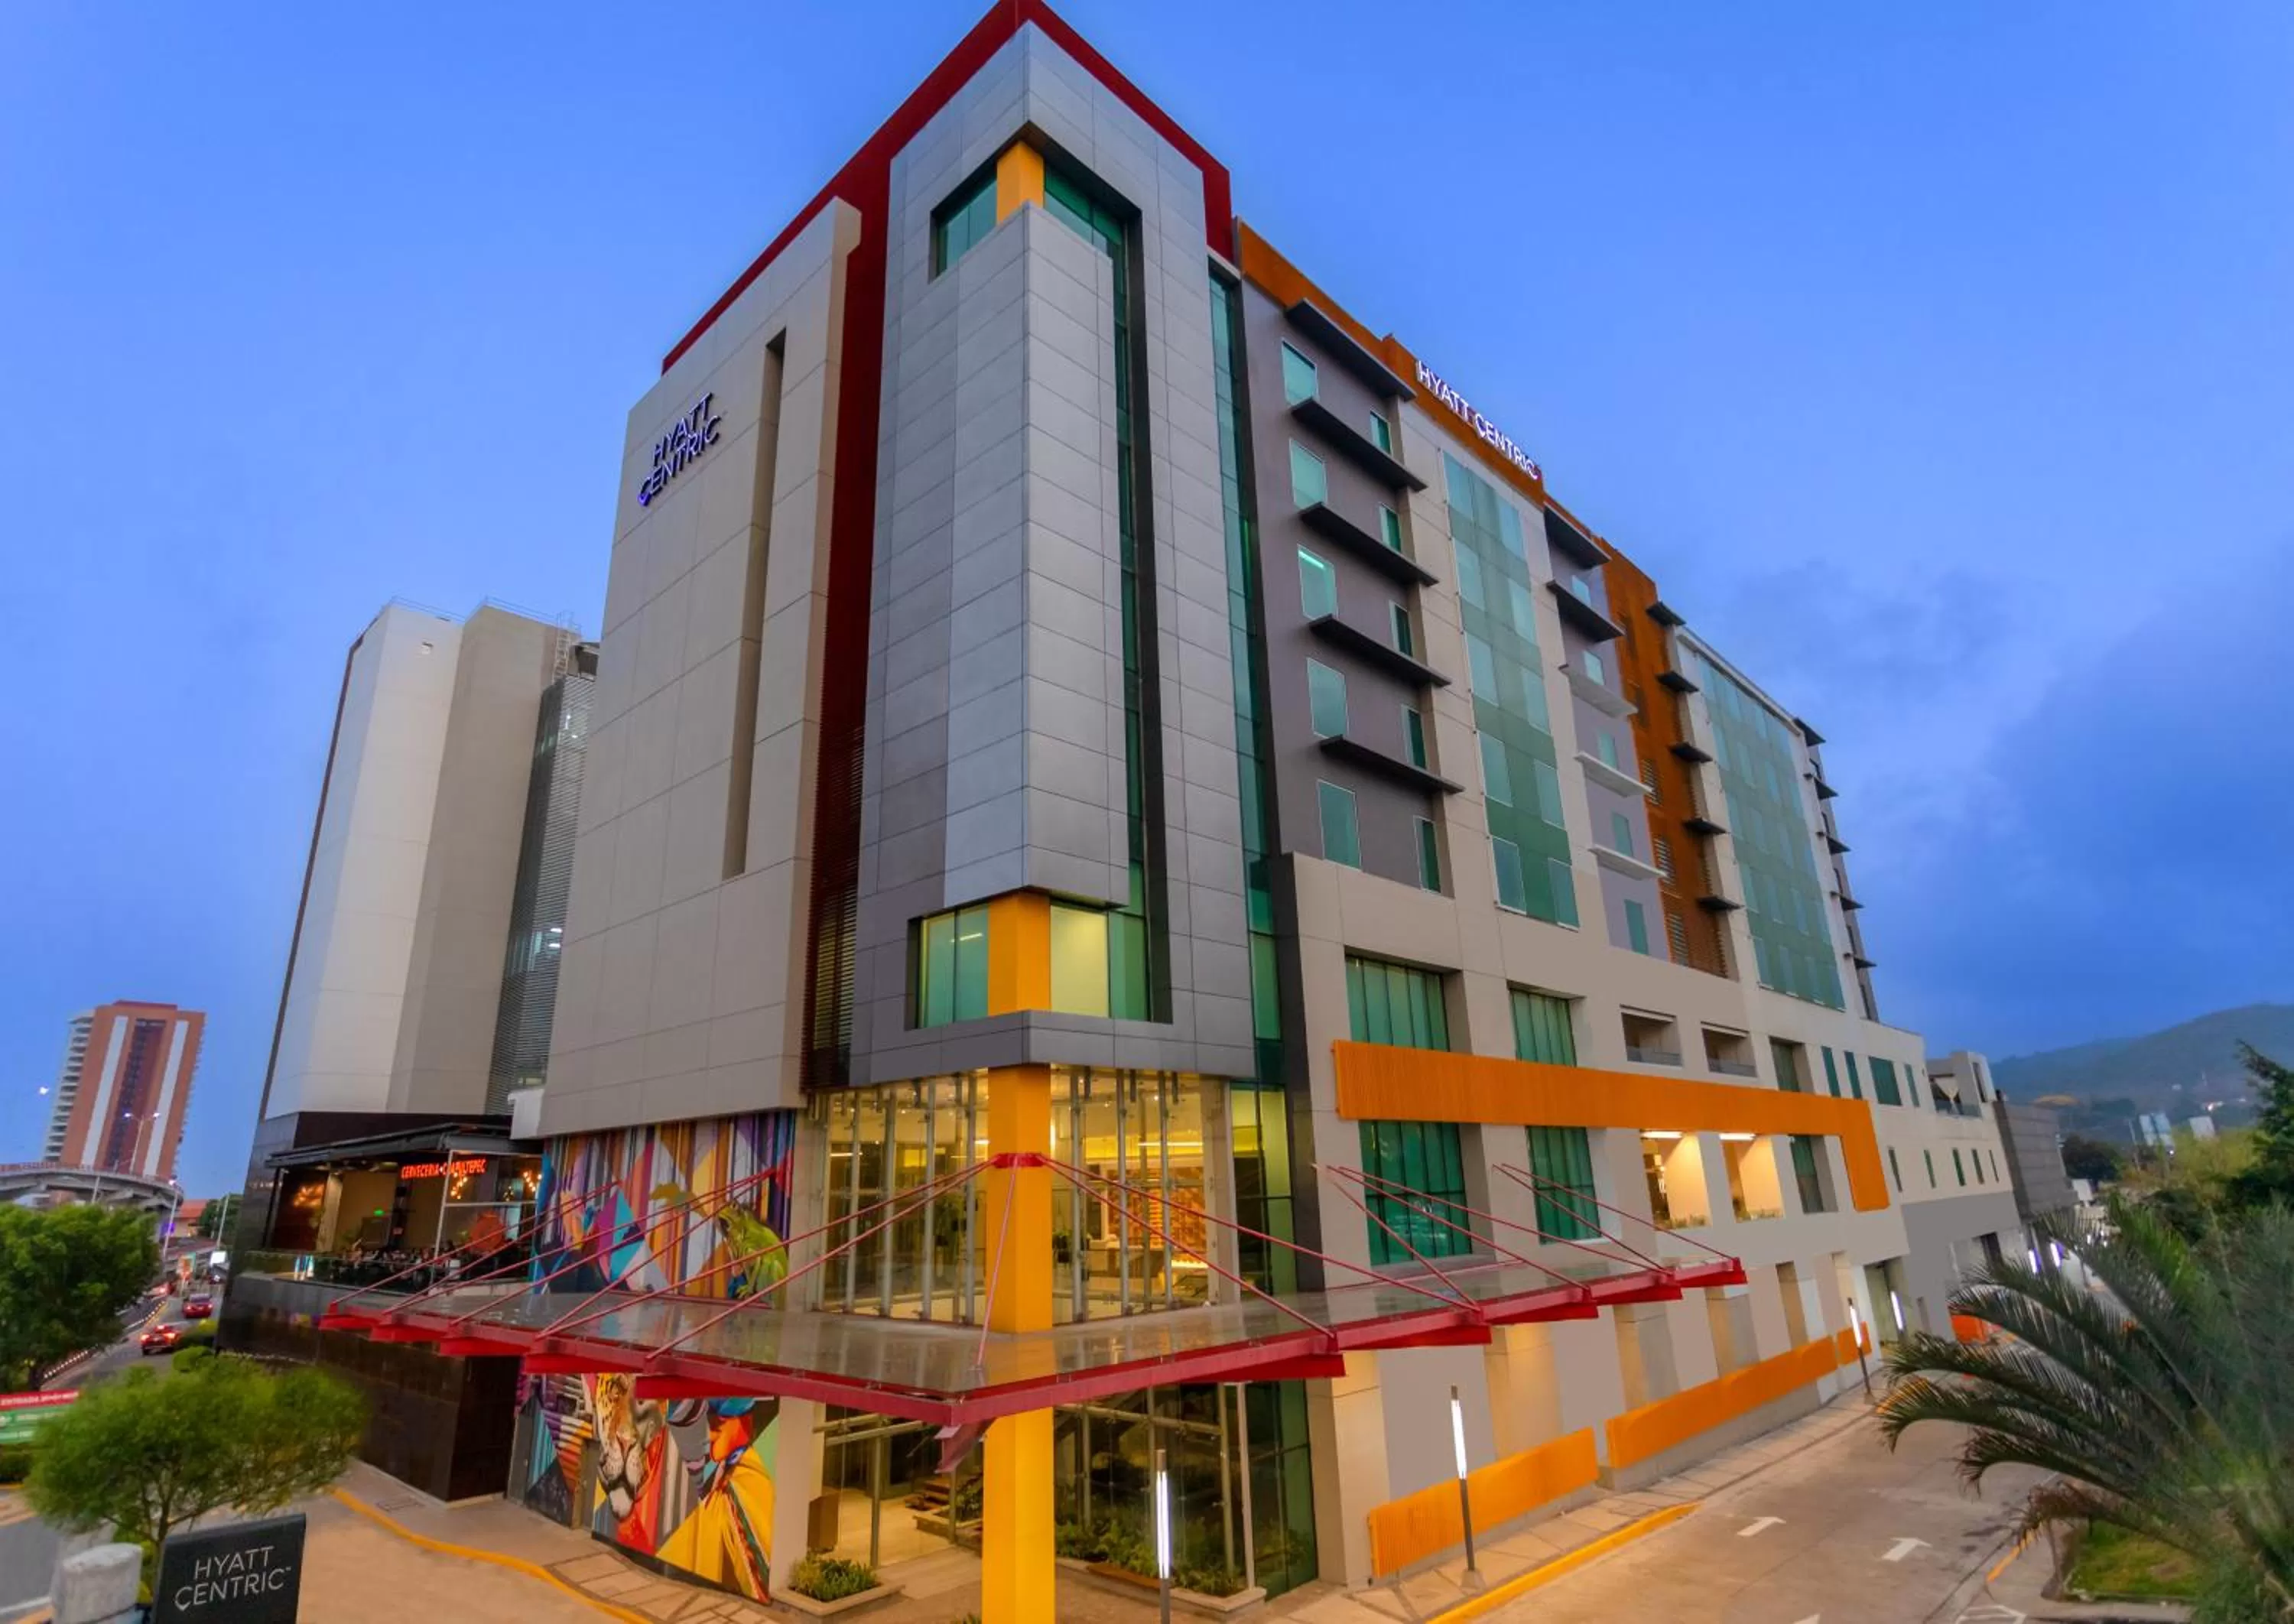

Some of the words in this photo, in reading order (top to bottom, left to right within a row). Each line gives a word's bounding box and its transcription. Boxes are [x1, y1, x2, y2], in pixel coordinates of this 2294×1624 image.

[653, 391, 713, 466] HYATT
[1418, 360, 1469, 421] HYATT
[1474, 412, 1539, 480] CENTRIC
[638, 415, 721, 506] CENTRIC
[174, 1567, 285, 1612] CENTRIC
[193, 1545, 275, 1580] HYATT
